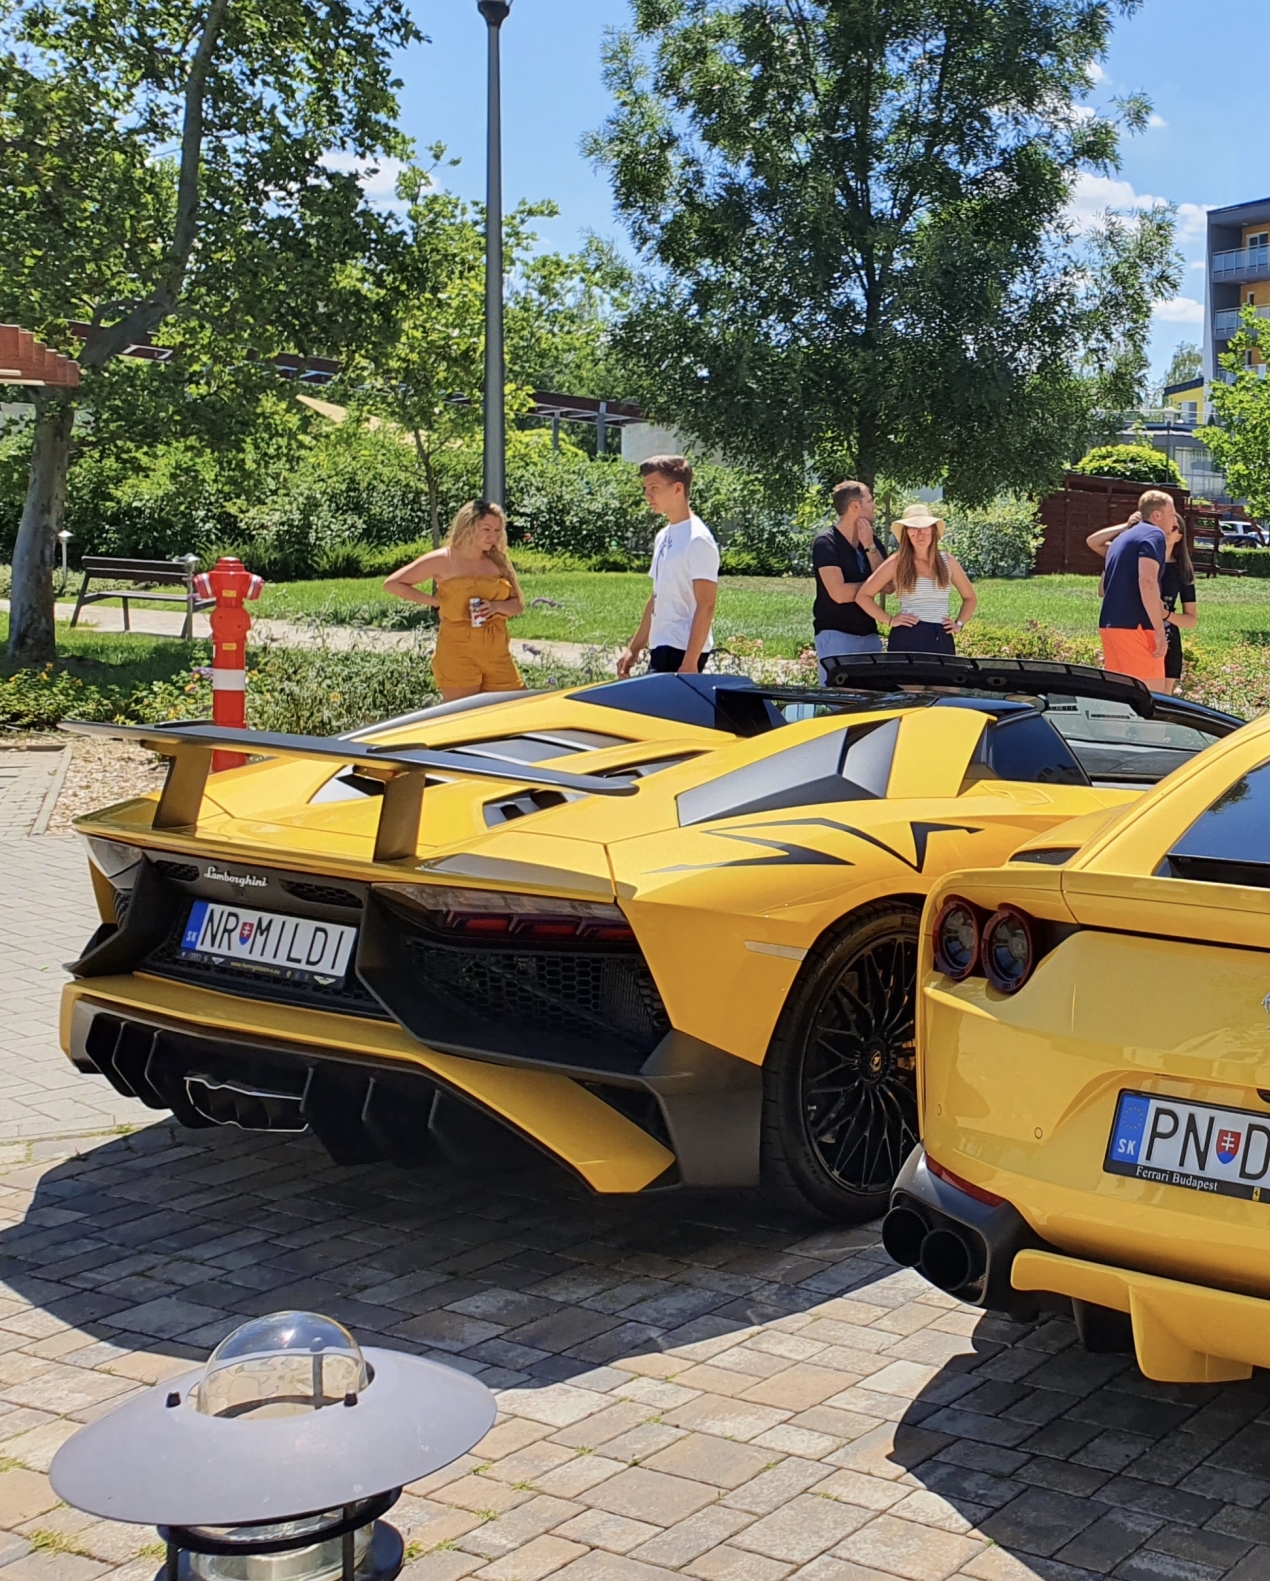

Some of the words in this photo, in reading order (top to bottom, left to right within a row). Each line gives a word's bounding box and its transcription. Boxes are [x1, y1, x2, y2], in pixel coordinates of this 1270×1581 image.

[204, 866, 269, 887] Lamborghini
[186, 931, 198, 942] SK
[200, 908, 240, 951] NR
[249, 916, 345, 970] MILDI
[1117, 1138, 1136, 1156] SK
[1145, 1107, 1215, 1171] PN
[1136, 1165, 1170, 1184] Ferrari
[1172, 1172, 1218, 1192] Budapest
